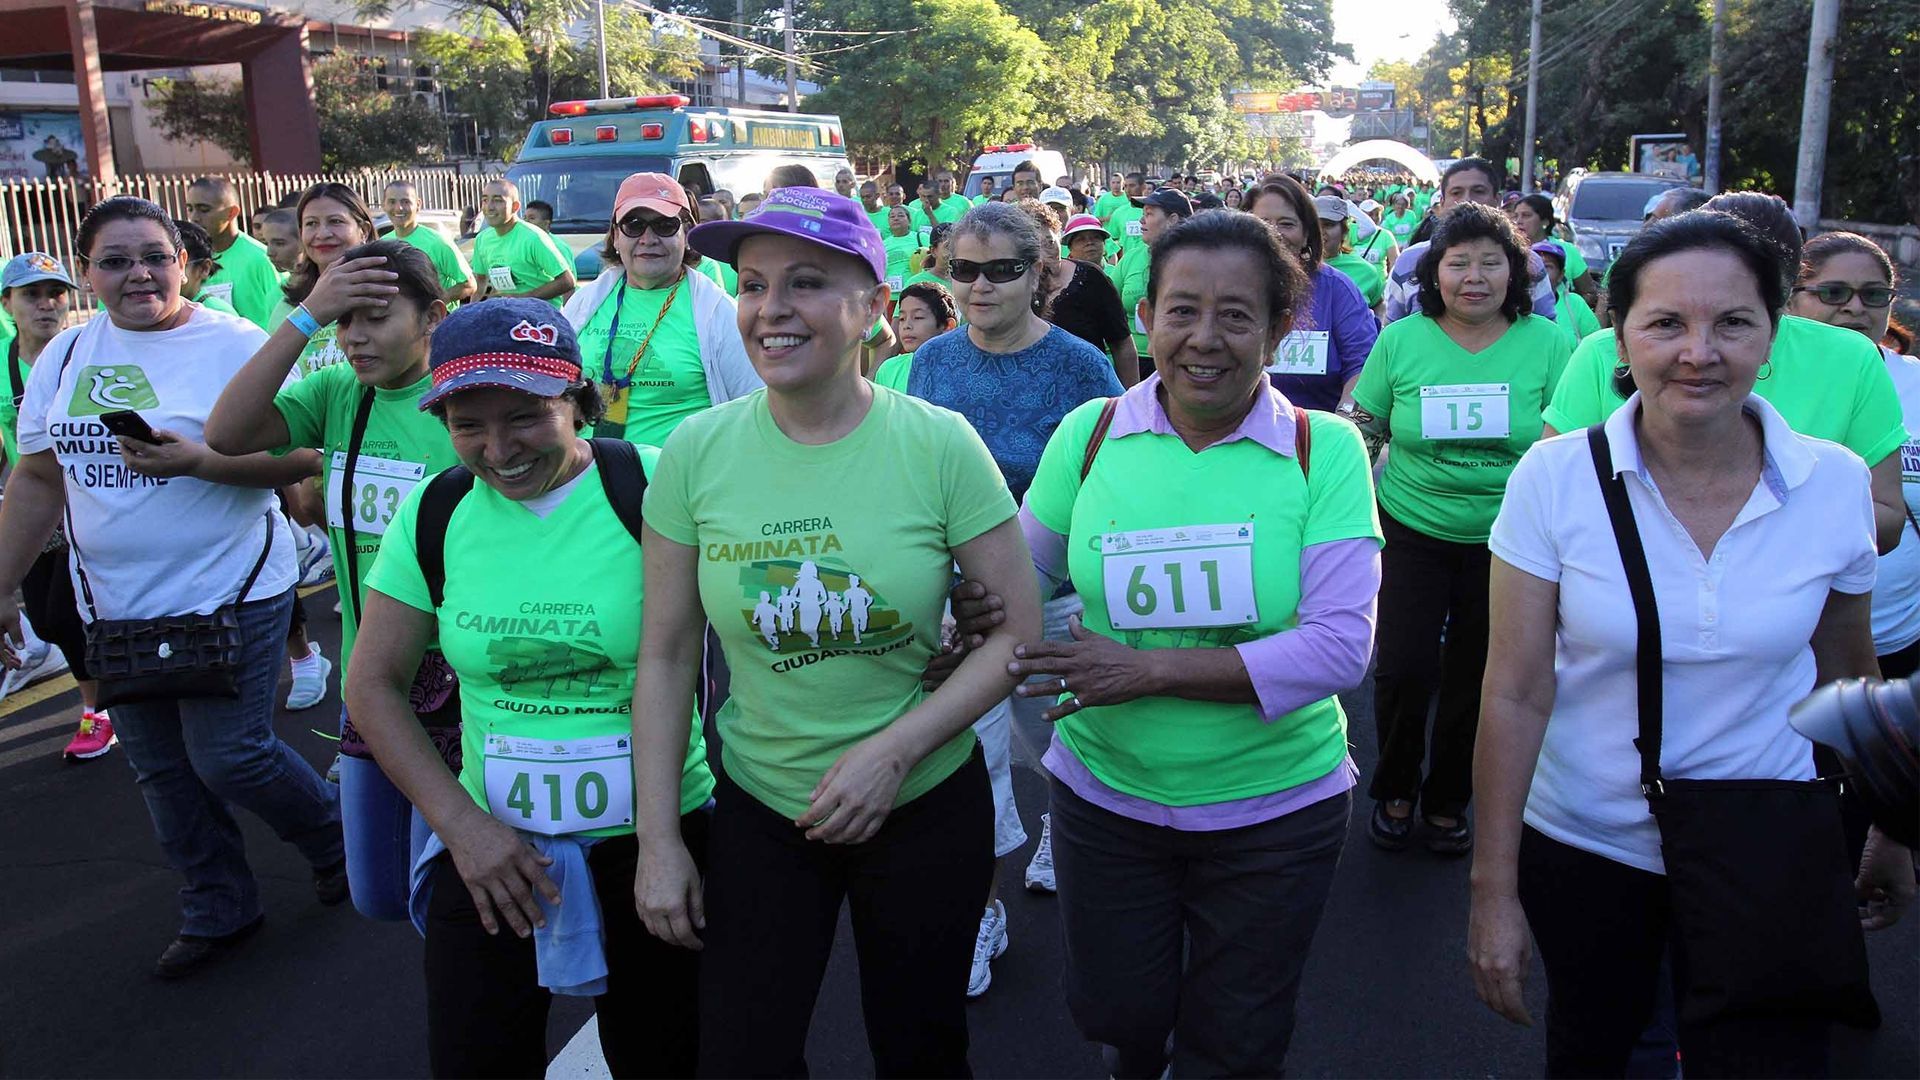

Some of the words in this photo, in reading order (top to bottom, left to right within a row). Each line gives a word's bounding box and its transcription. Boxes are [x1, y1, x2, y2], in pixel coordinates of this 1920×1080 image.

[146, 1, 209, 18] MINISTERIO
[211, 7, 227, 21] DE
[228, 9, 262, 25] SALUD
[752, 126, 816, 149] AMBULANCIA
[780, 195, 828, 213] SOCIEDAD
[784, 187, 831, 207] VIOLENCIA
[1446, 402, 1483, 431] 15
[1432, 457, 1479, 468] CIUDAD
[761, 516, 833, 536] CARRERA
[706, 533, 844, 563] CAMINATA
[1126, 559, 1223, 616] 611
[519, 601, 596, 616] CARRERA
[455, 611, 603, 637] CAMINATA
[770, 649, 849, 674] CIUDAD
[852, 633, 915, 657] MUJER
[493, 699, 570, 715] CIUDAD
[506, 770, 609, 822] 410
